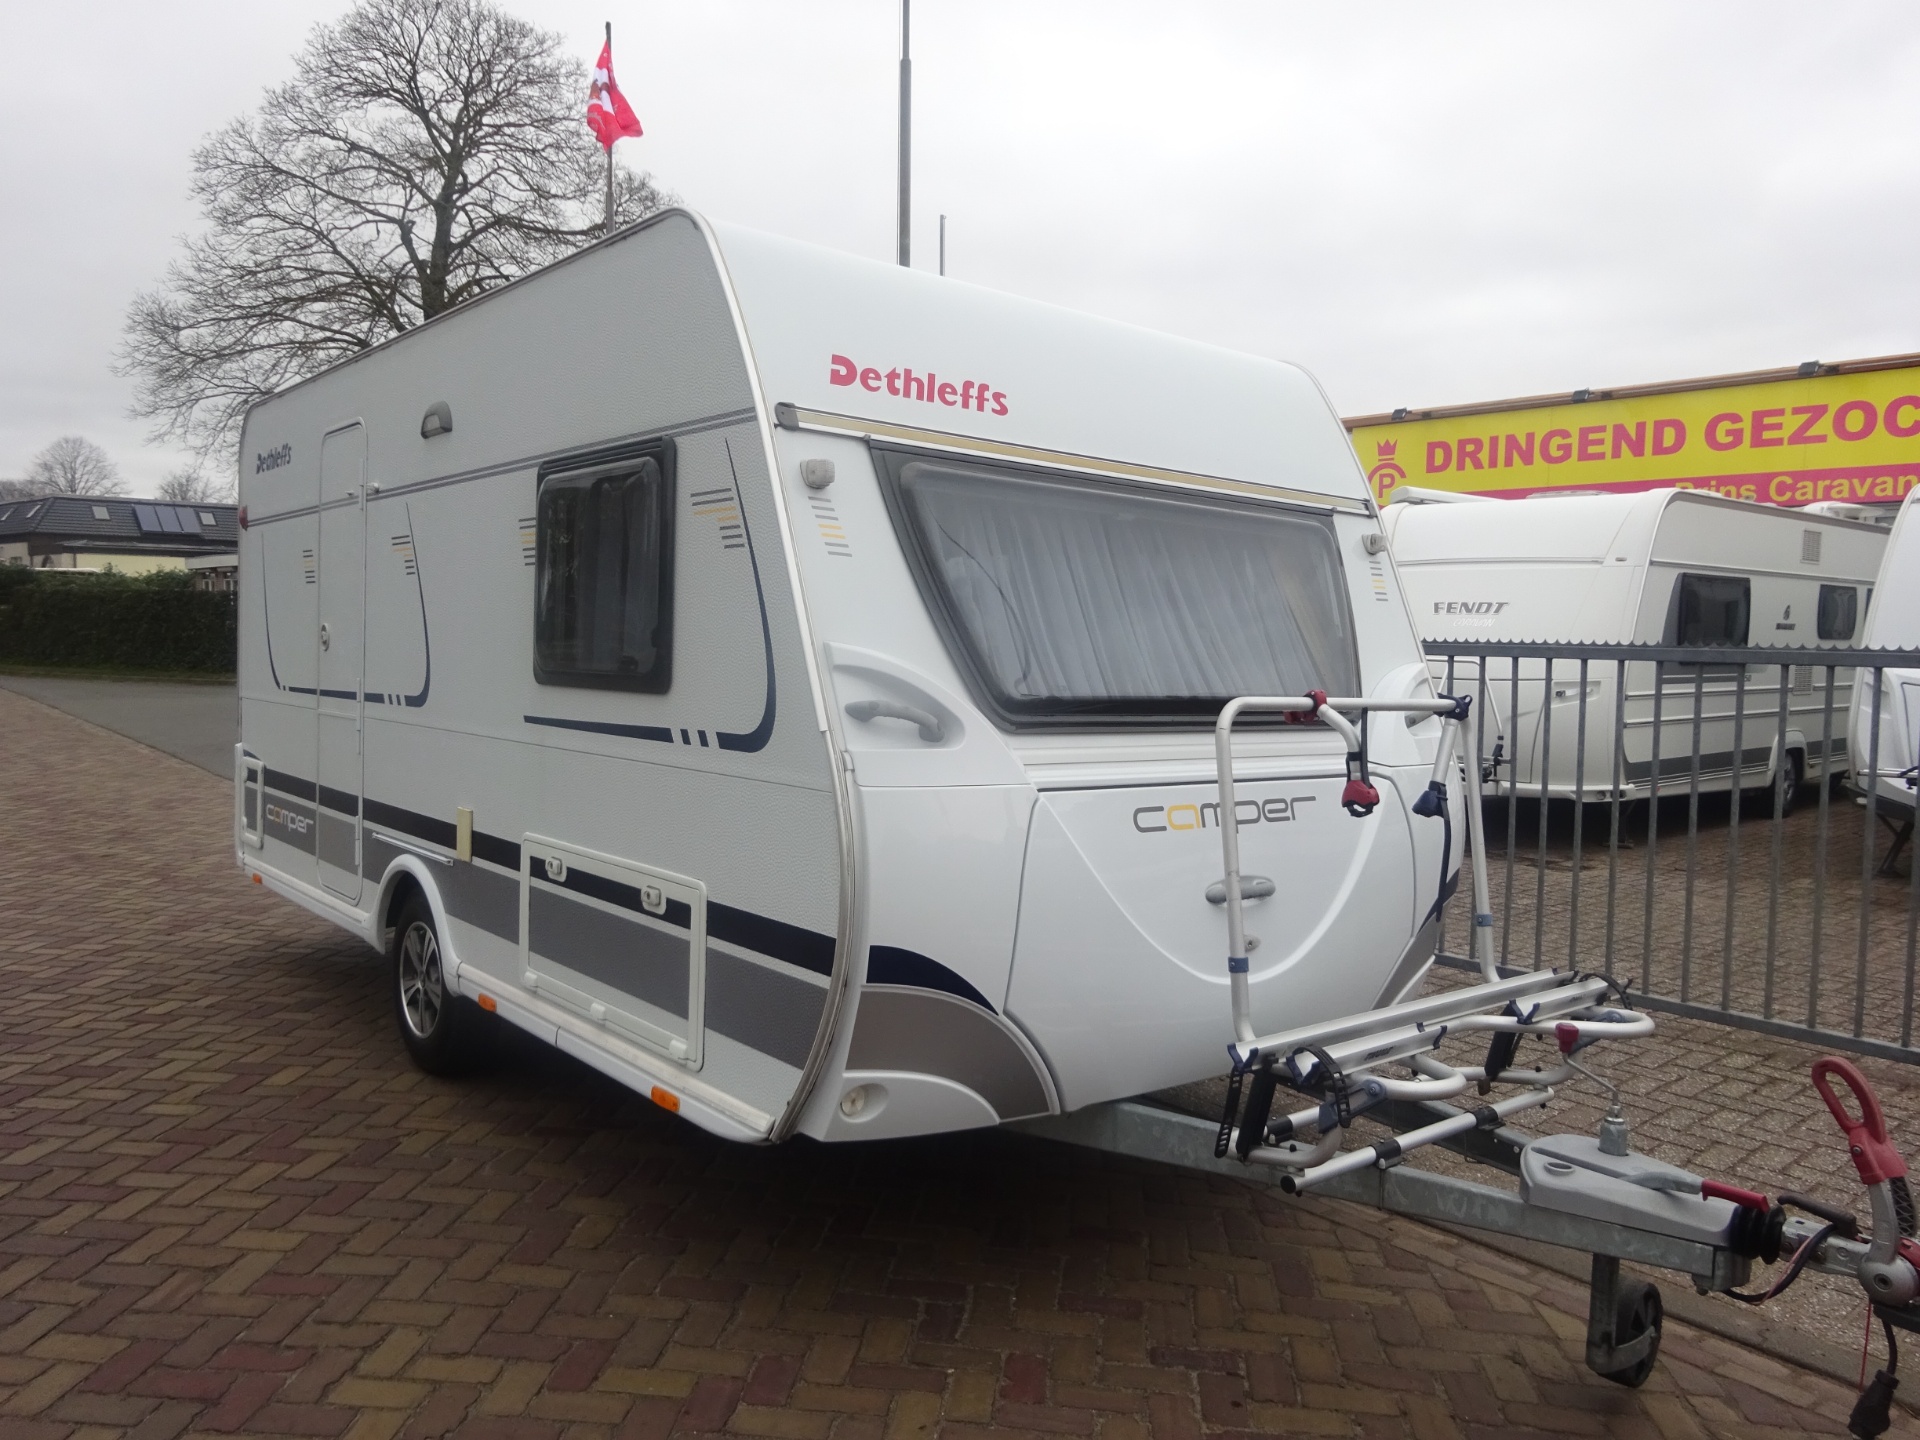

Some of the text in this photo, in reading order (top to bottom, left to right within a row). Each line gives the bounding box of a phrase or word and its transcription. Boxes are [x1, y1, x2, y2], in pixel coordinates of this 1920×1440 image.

[830, 354, 1009, 416] Dethleffs
[1425, 395, 1920, 473] DRINGEND GEZOC
[256, 443, 291, 474] Dethleffs
[1675, 480, 1757, 502] ins
[1433, 601, 1509, 615] FENDT
[265, 803, 314, 834] camper
[1133, 796, 1316, 834] camper
